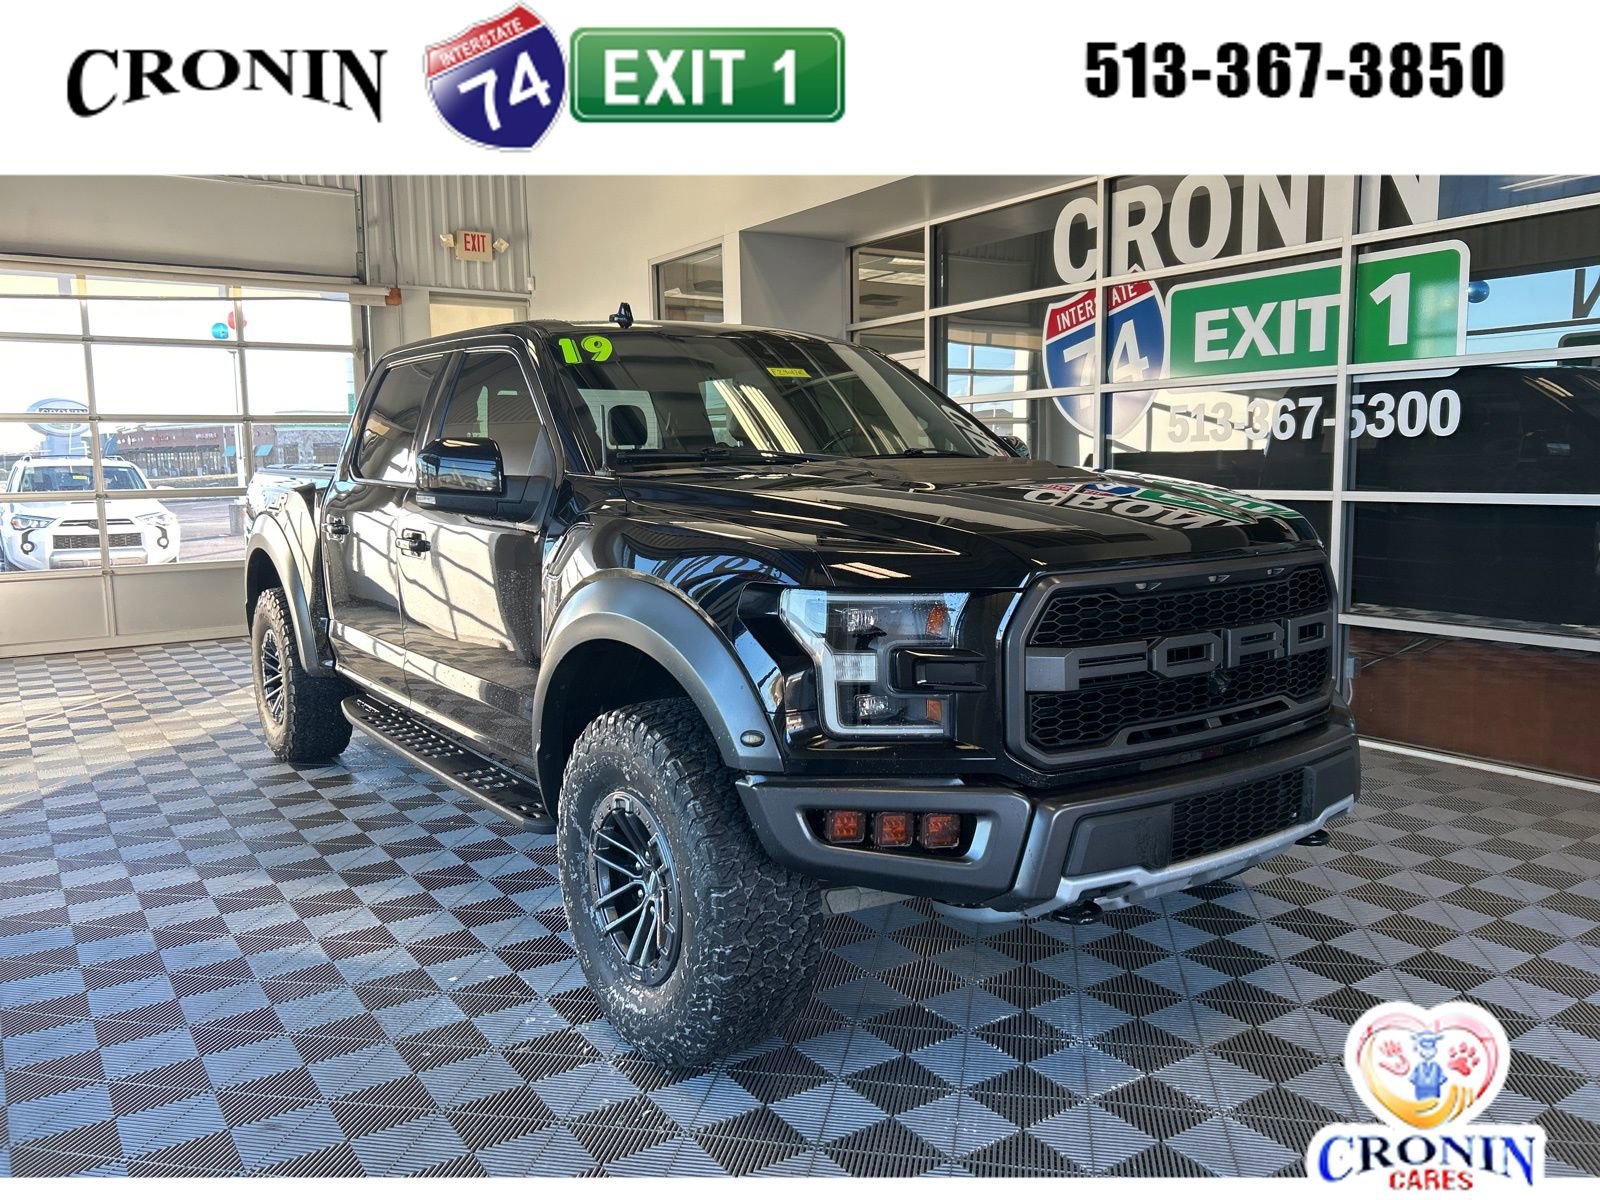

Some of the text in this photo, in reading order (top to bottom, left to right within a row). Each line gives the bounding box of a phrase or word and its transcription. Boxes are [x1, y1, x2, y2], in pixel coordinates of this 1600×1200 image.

[463, 233, 486, 253] EXIT
[1194, 272, 1411, 364] EXIT 1
[559, 336, 613, 364] 19
[1167, 388, 1461, 444] 513-367-5300
[1064, 611, 1330, 692] FORD
